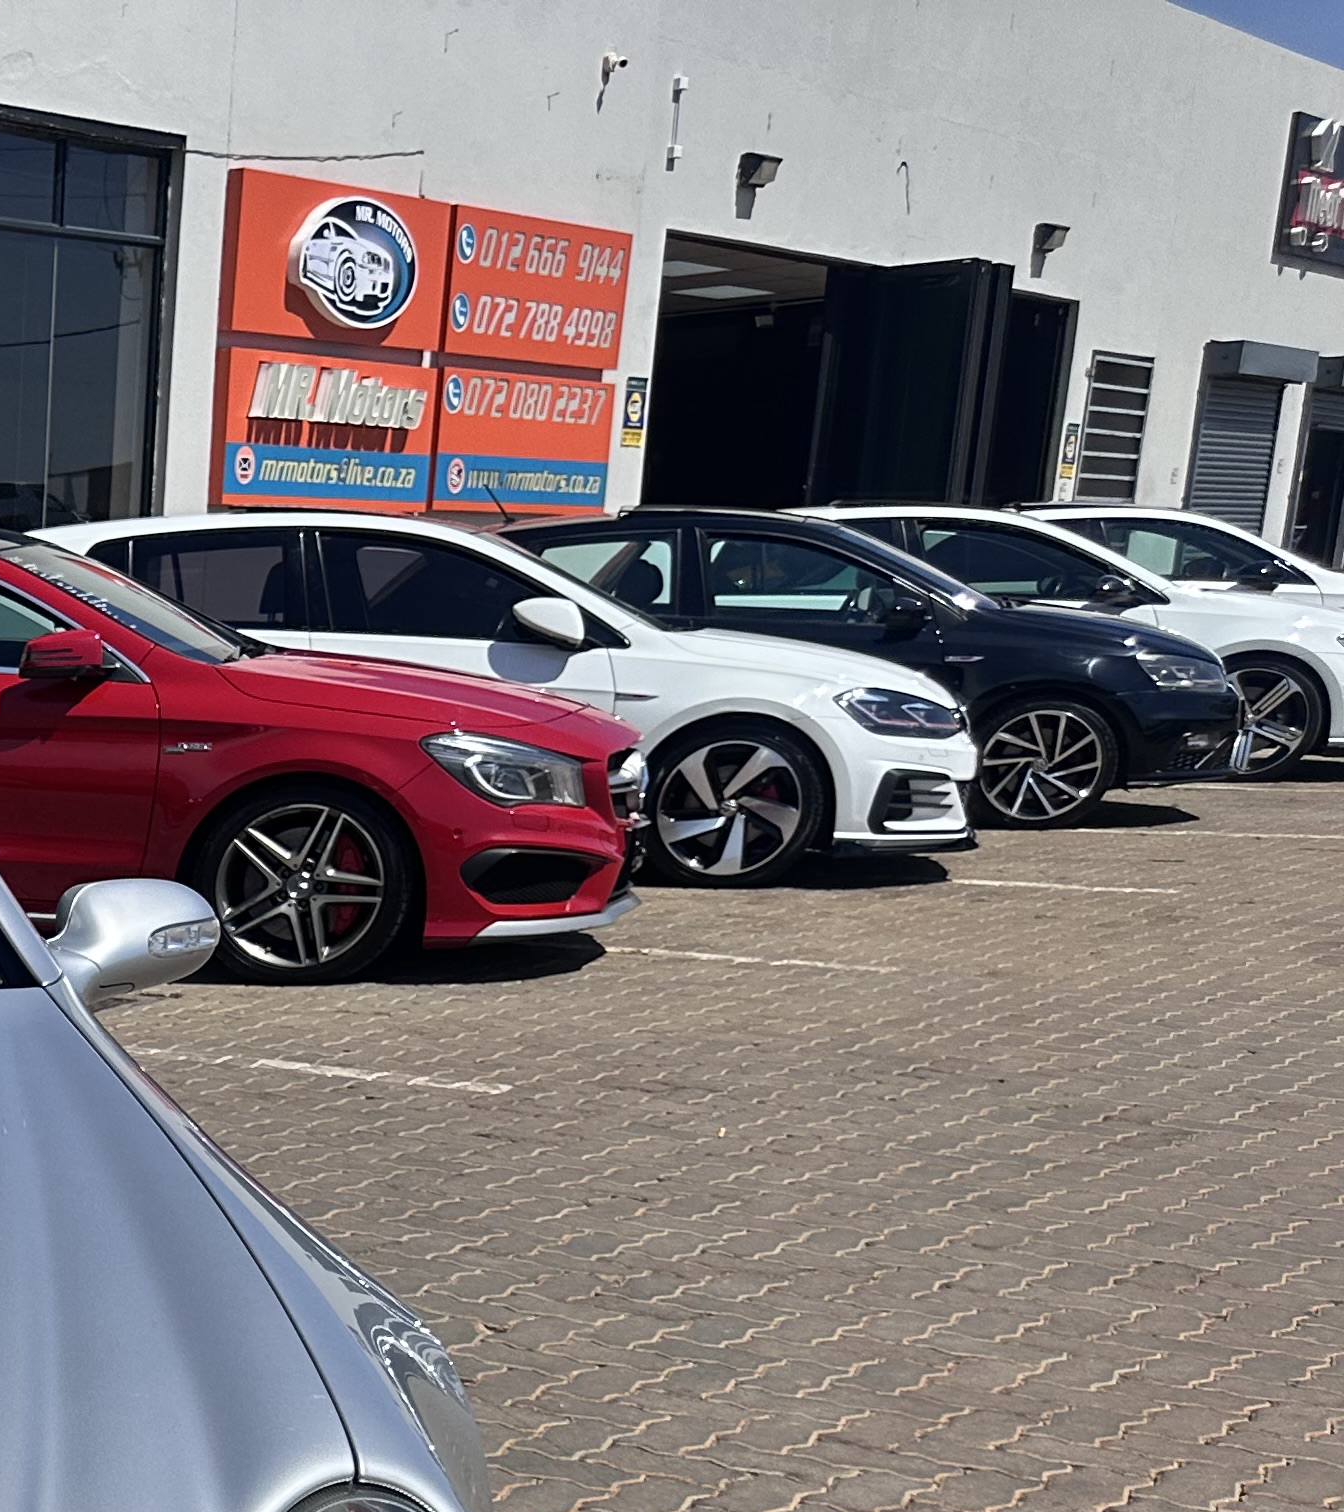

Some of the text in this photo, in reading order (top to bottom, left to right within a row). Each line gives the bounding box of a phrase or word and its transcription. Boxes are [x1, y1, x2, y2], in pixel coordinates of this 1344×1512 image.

[355, 205, 413, 263] MR. MOTORS
[479, 227, 625, 285] 012 666 9144
[473, 295, 616, 348] 072 788 4998
[309, 368, 427, 430] Motors
[464, 377, 509, 417] 072
[509, 381, 552, 422] 080
[552, 386, 607, 425] 2237
